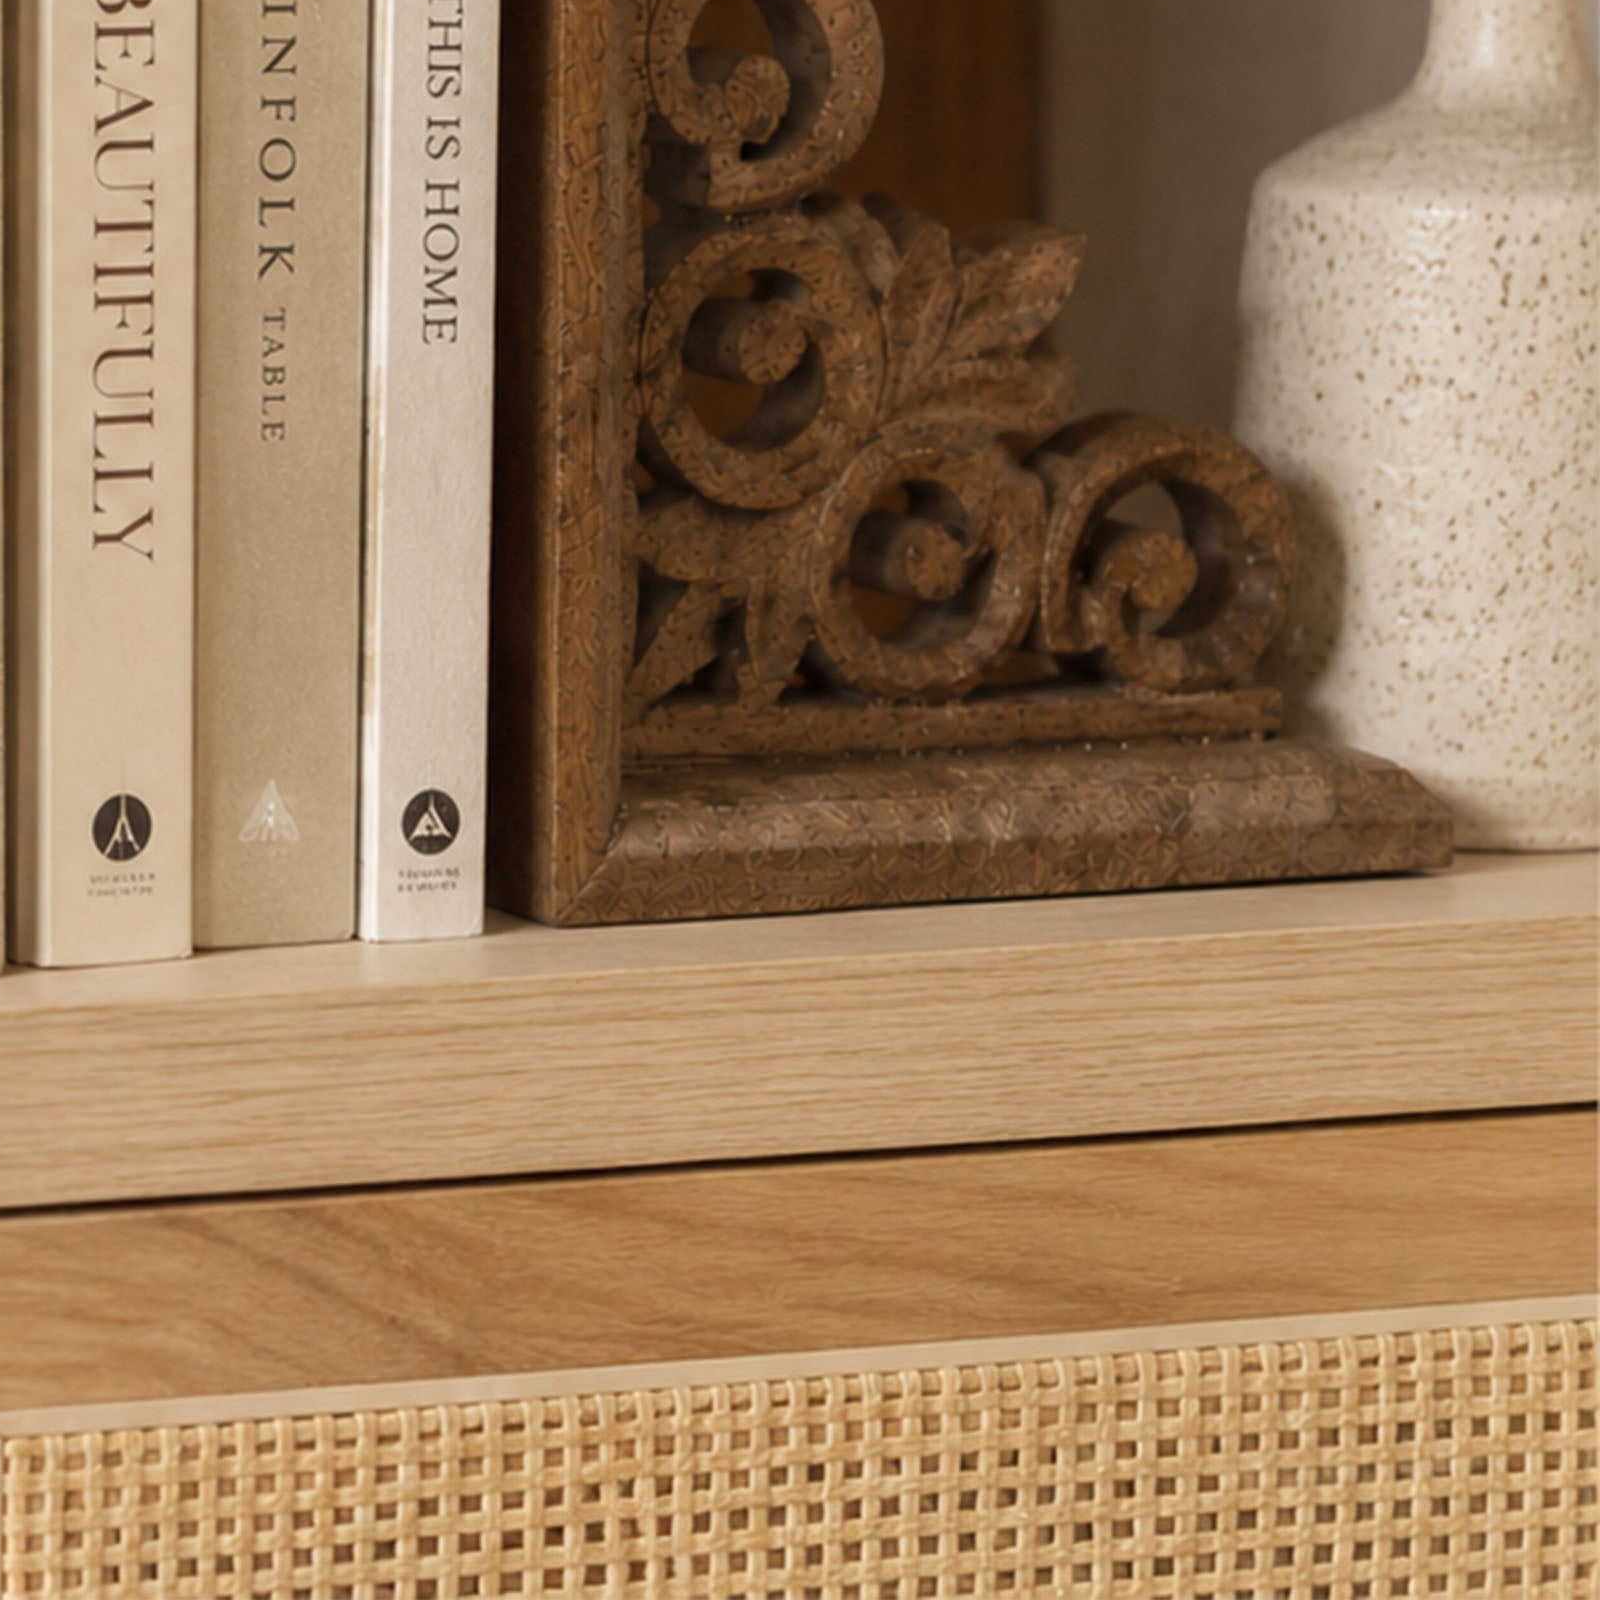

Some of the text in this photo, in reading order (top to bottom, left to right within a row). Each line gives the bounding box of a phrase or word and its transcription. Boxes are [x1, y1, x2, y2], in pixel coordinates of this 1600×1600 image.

[425, 116, 461, 161] IS
[422, 180, 460, 345] HOME
[261, 307, 287, 441] TABLE
